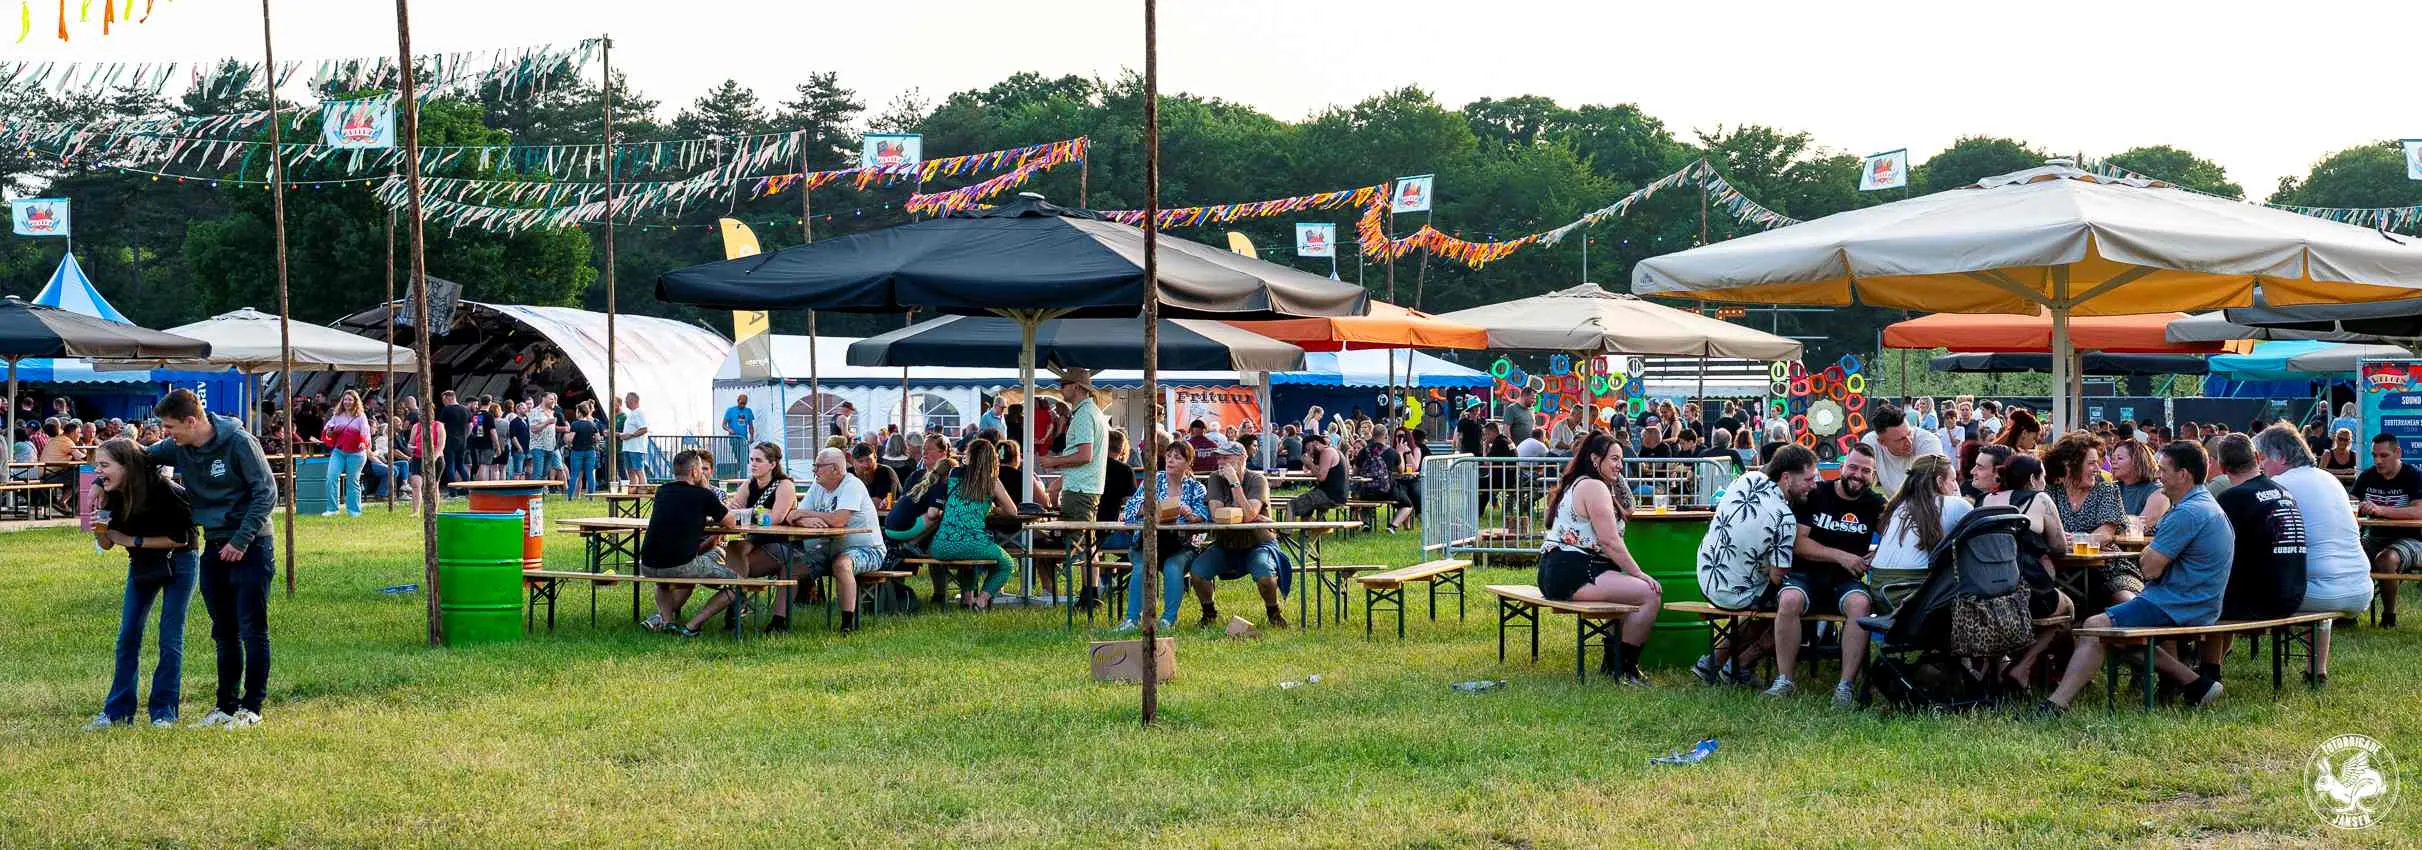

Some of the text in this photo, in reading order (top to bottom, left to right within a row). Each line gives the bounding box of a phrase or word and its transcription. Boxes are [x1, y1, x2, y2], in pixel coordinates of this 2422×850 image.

[2401, 396, 2422, 405] SOUND
[1812, 512, 1868, 534] ellesse
[2273, 546, 2298, 554] EUROPE
